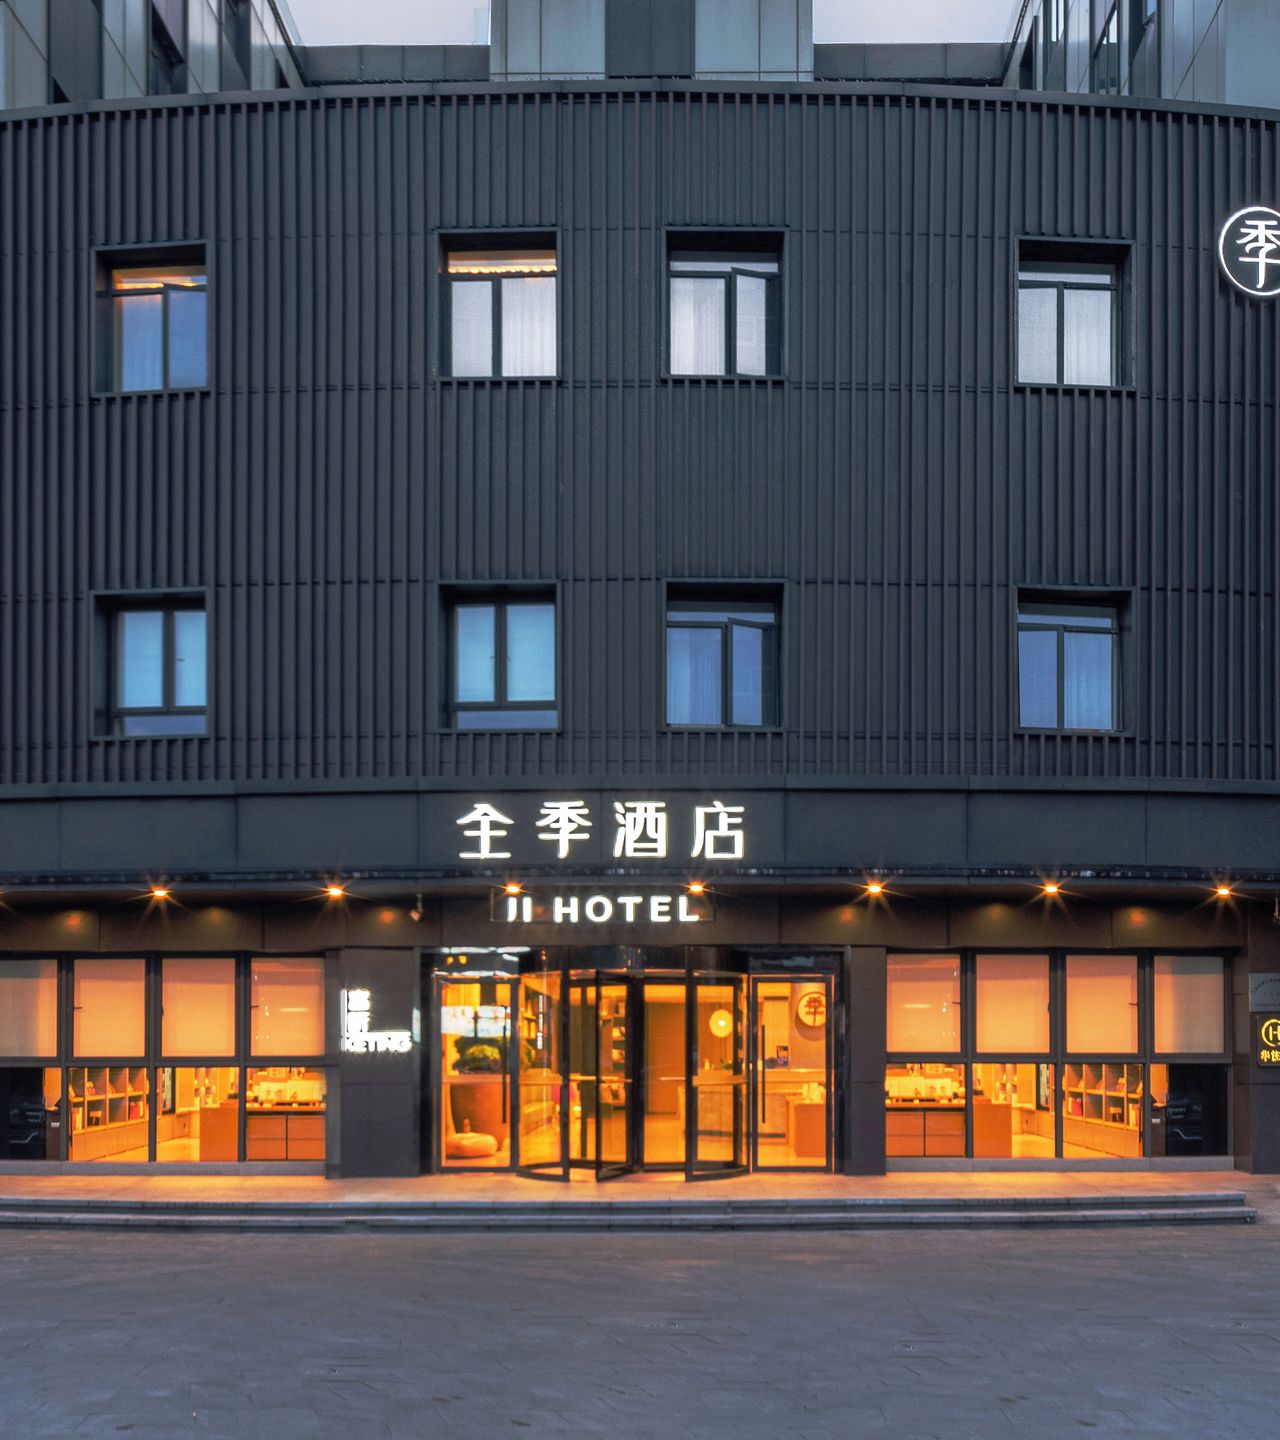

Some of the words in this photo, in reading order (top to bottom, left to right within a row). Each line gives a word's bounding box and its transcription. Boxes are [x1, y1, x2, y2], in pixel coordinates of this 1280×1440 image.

[456, 800, 745, 860] 全季酒店
[552, 895, 700, 923] HOTEL
